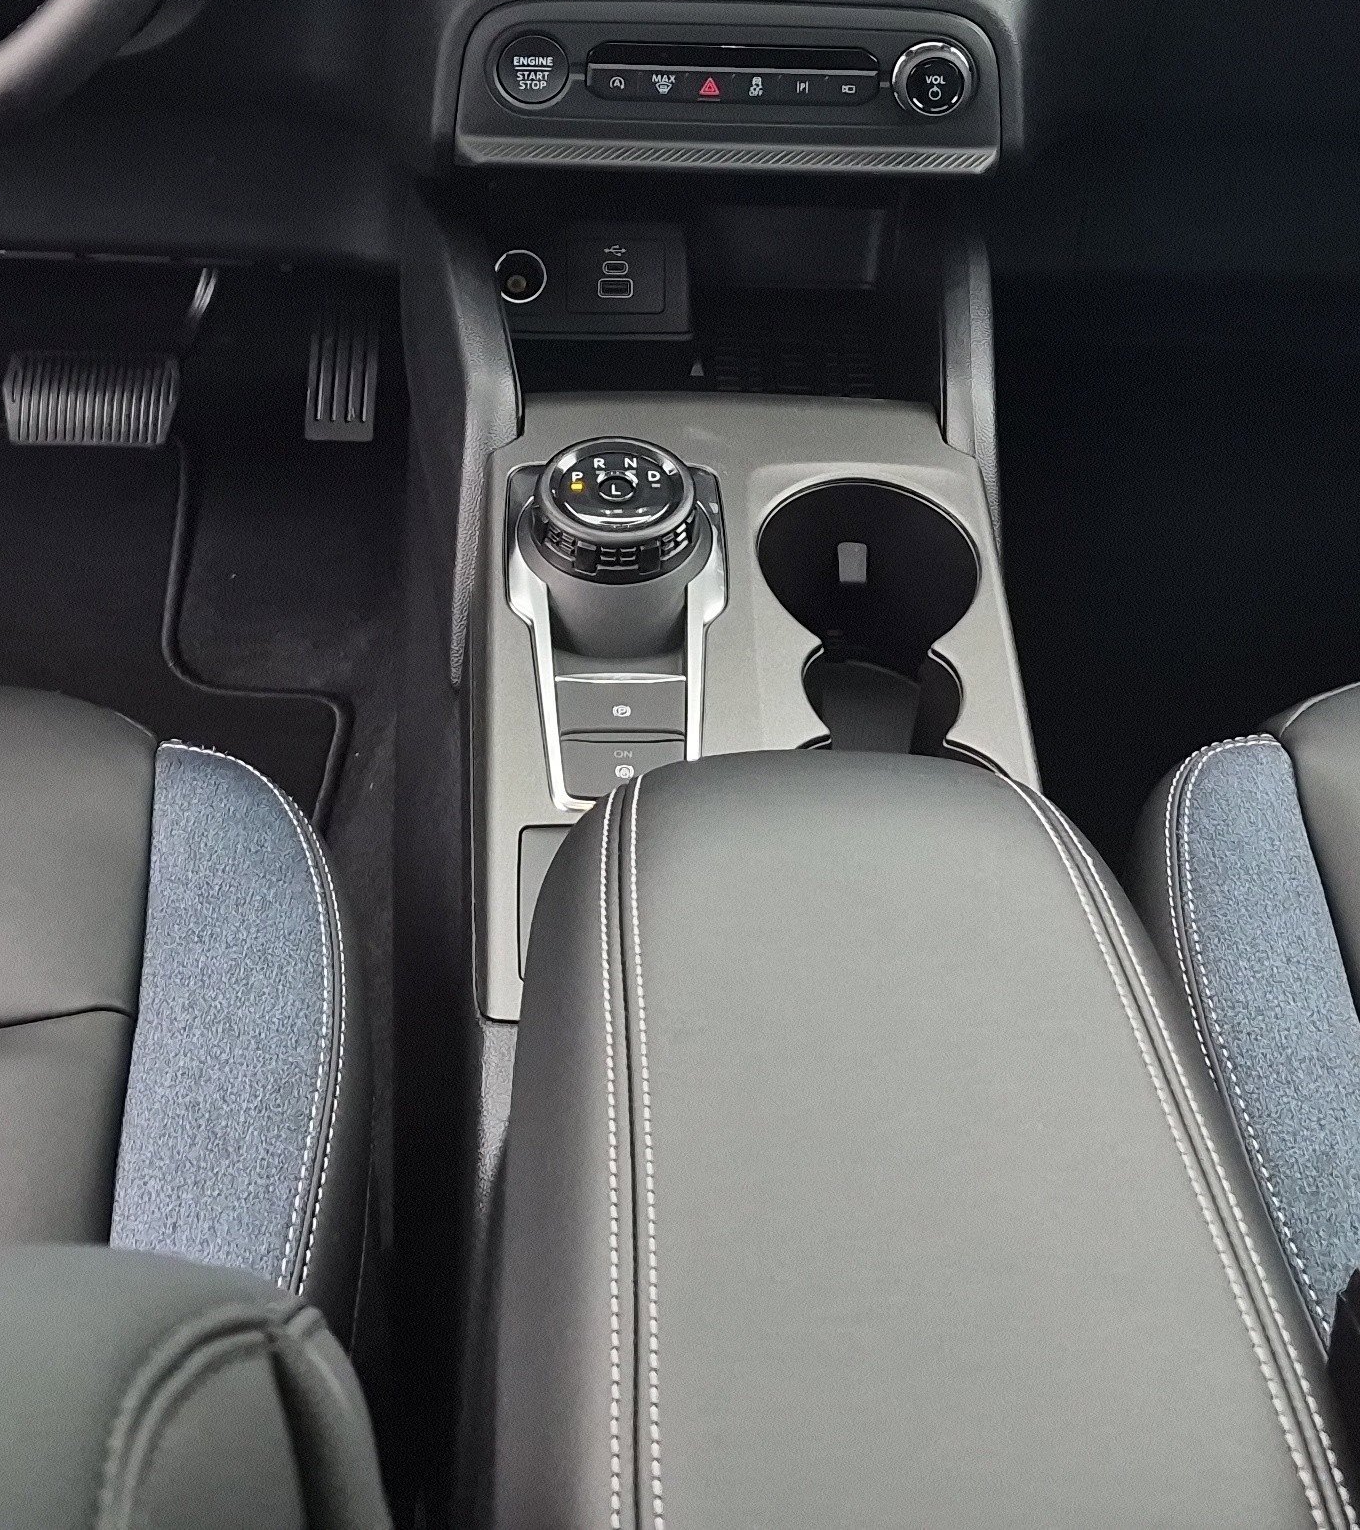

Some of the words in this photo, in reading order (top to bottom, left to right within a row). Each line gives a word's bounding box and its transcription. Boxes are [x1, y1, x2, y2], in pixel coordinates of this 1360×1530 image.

[513, 56, 554, 66] ENGINE
[516, 71, 550, 80] START
[651, 73, 676, 83] MAX
[925, 75, 946, 85] VOL
[519, 80, 547, 90] STOP
[593, 457, 606, 469] R
[624, 457, 638, 468] N
[571, 471, 584, 482] P
[647, 470, 661, 482] D
[611, 483, 621, 495] L
[613, 750, 633, 758] ON
